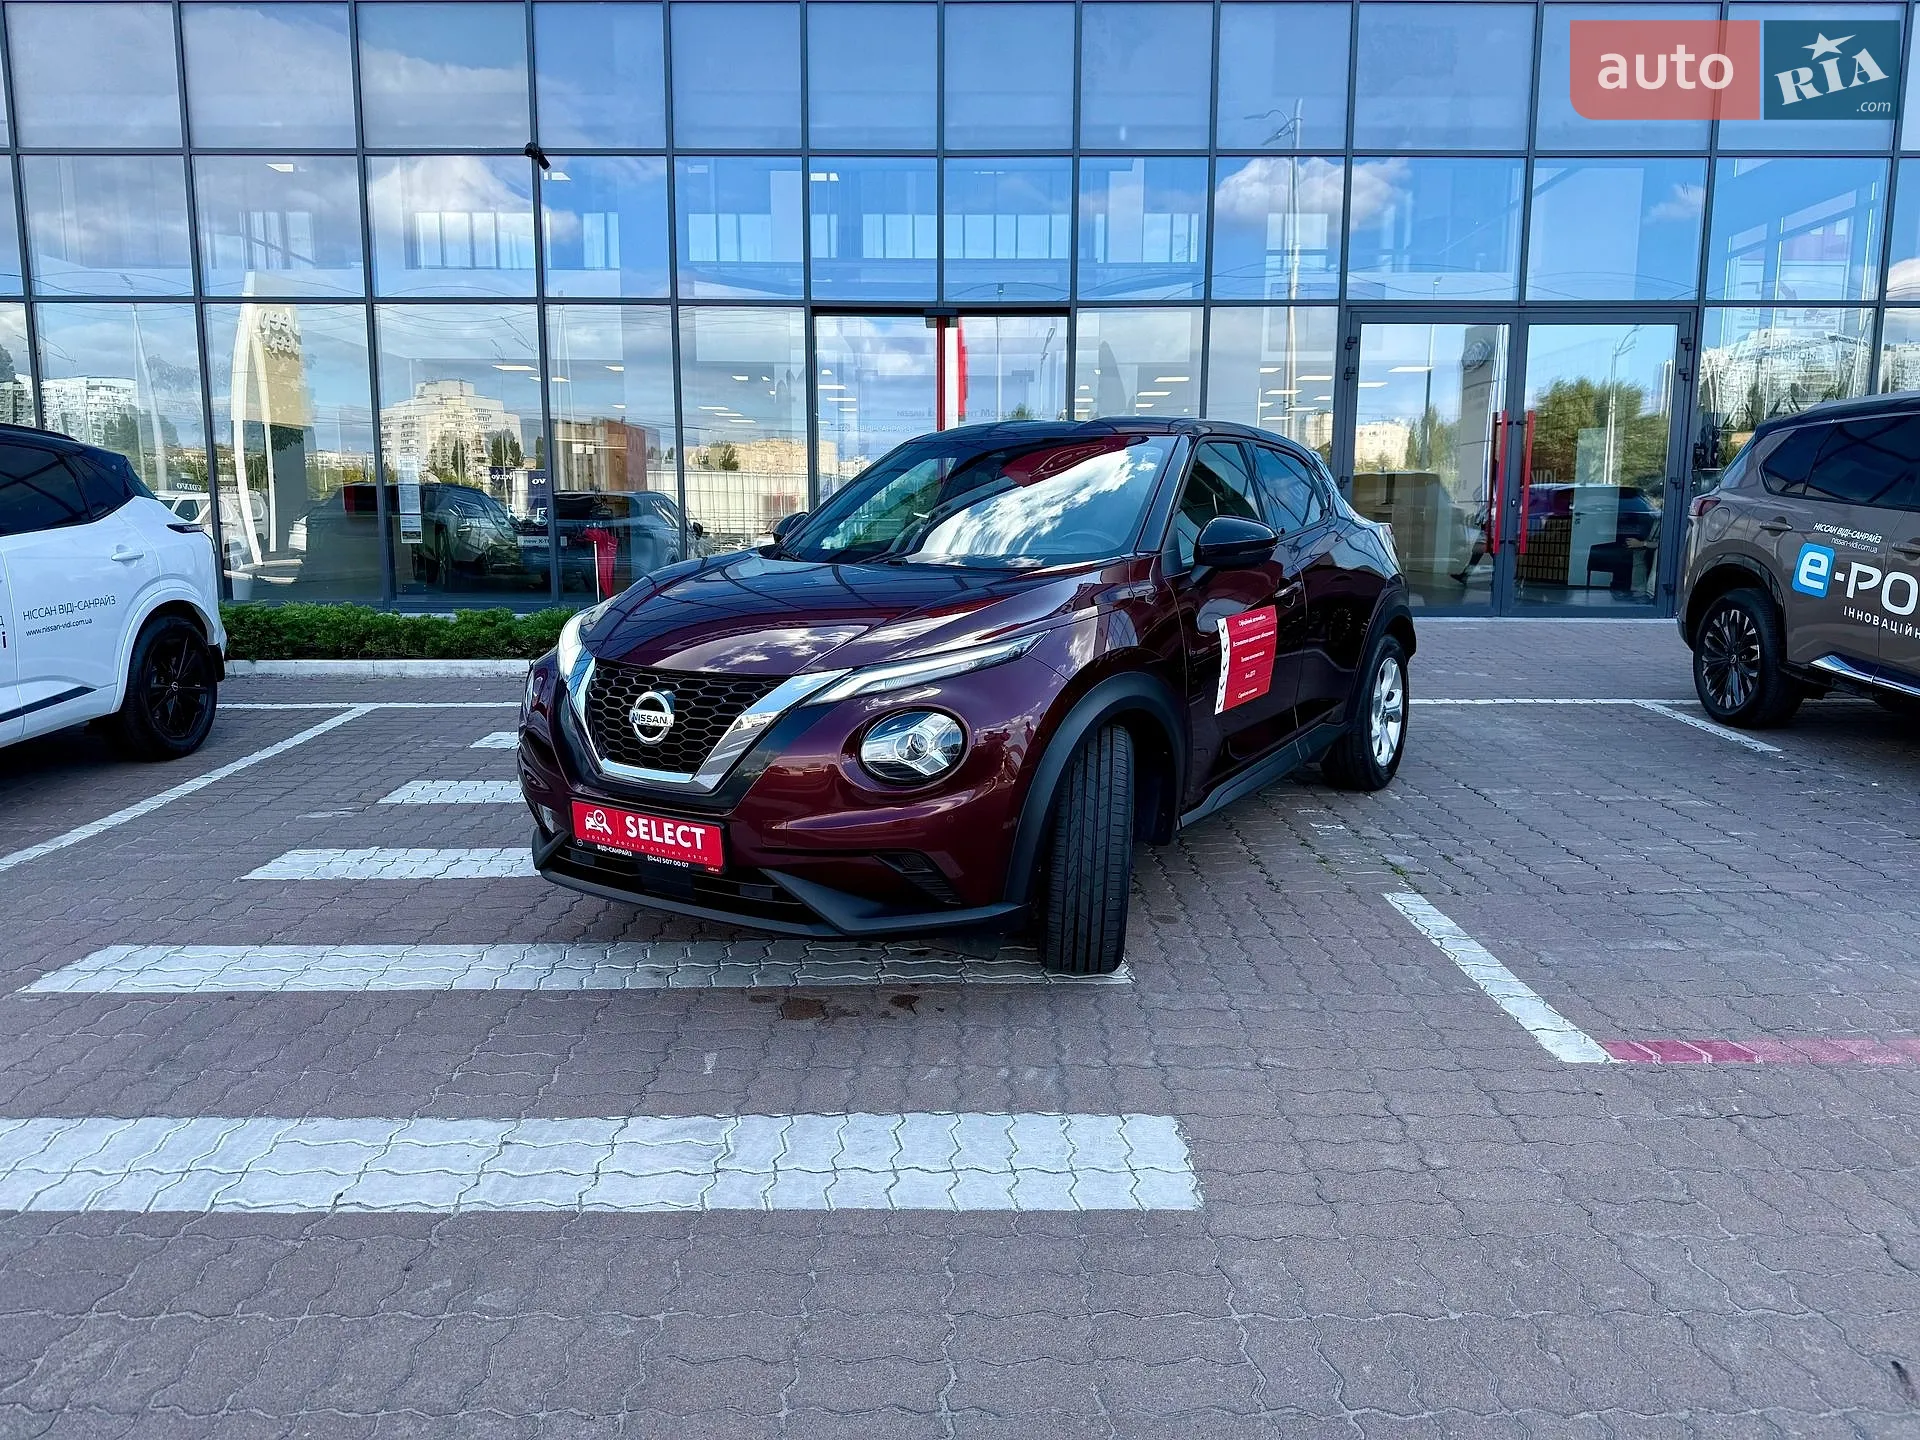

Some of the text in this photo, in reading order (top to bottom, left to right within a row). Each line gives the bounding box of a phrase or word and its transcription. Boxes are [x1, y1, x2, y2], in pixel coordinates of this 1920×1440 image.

[22, 594, 117, 621] НІССАН ВІДІ-САНРАЙЗ
[632, 711, 668, 724] NISSAN
[625, 815, 706, 850] SELECT
